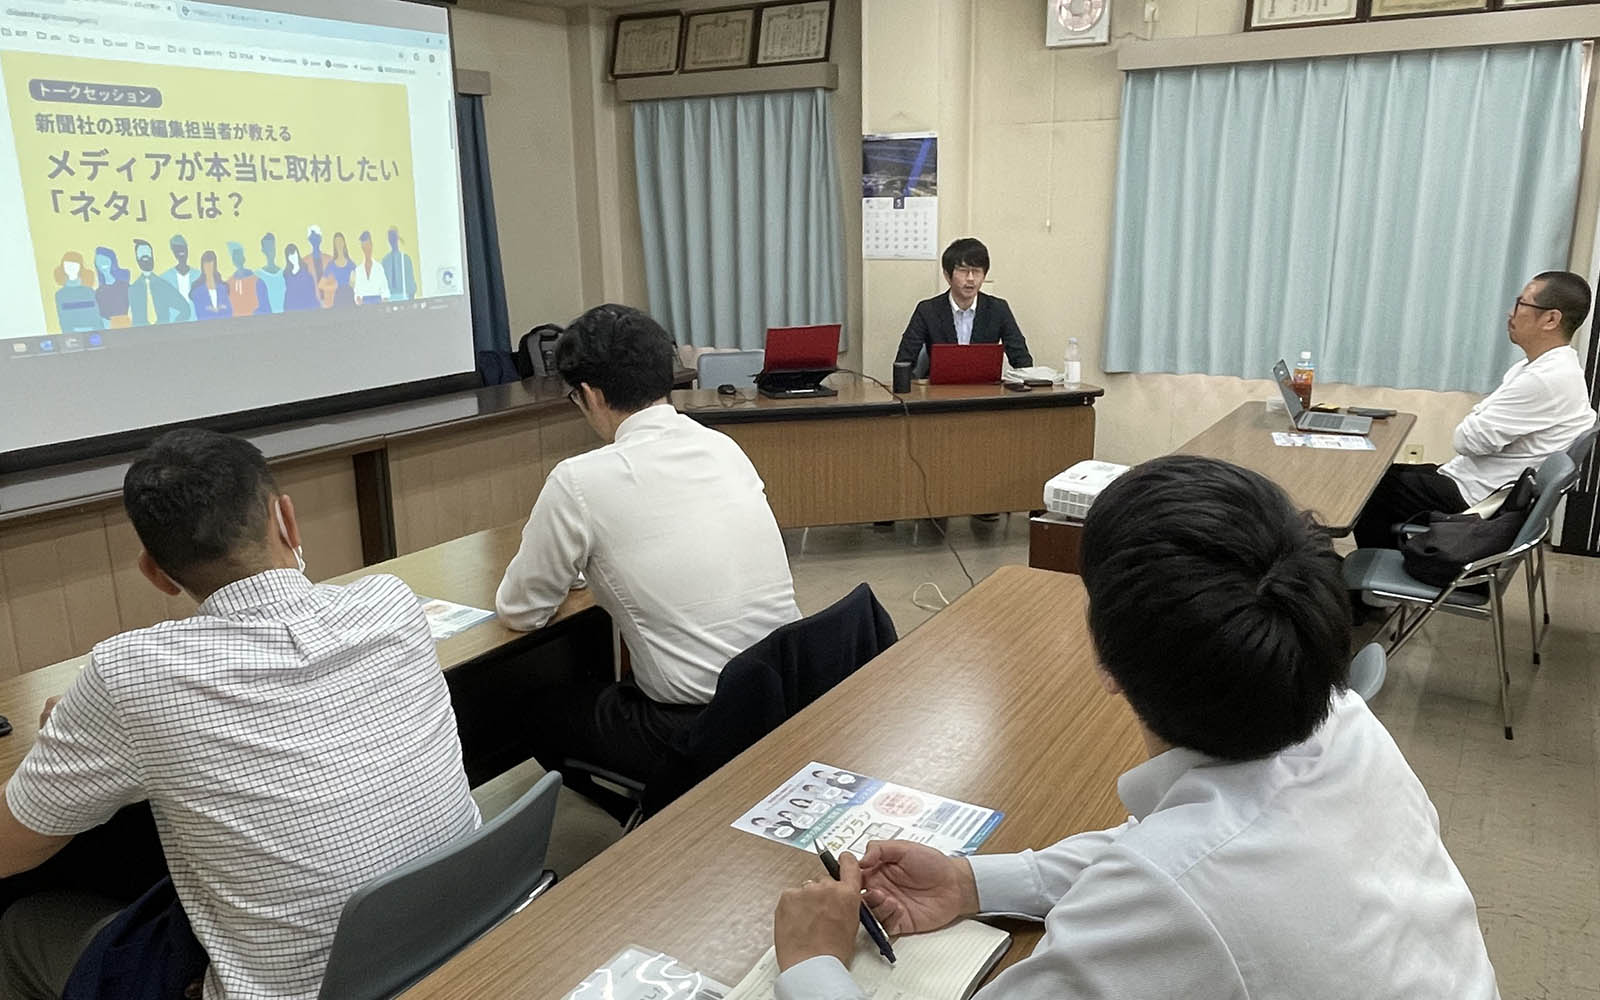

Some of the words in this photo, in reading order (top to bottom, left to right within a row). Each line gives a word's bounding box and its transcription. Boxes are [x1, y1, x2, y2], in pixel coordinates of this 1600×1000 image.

[41, 83, 151, 104] トークセッション
[35, 113, 291, 142] 新聞社の現役編集担当者が教える
[48, 149, 399, 183] メディアが本当に取材したい
